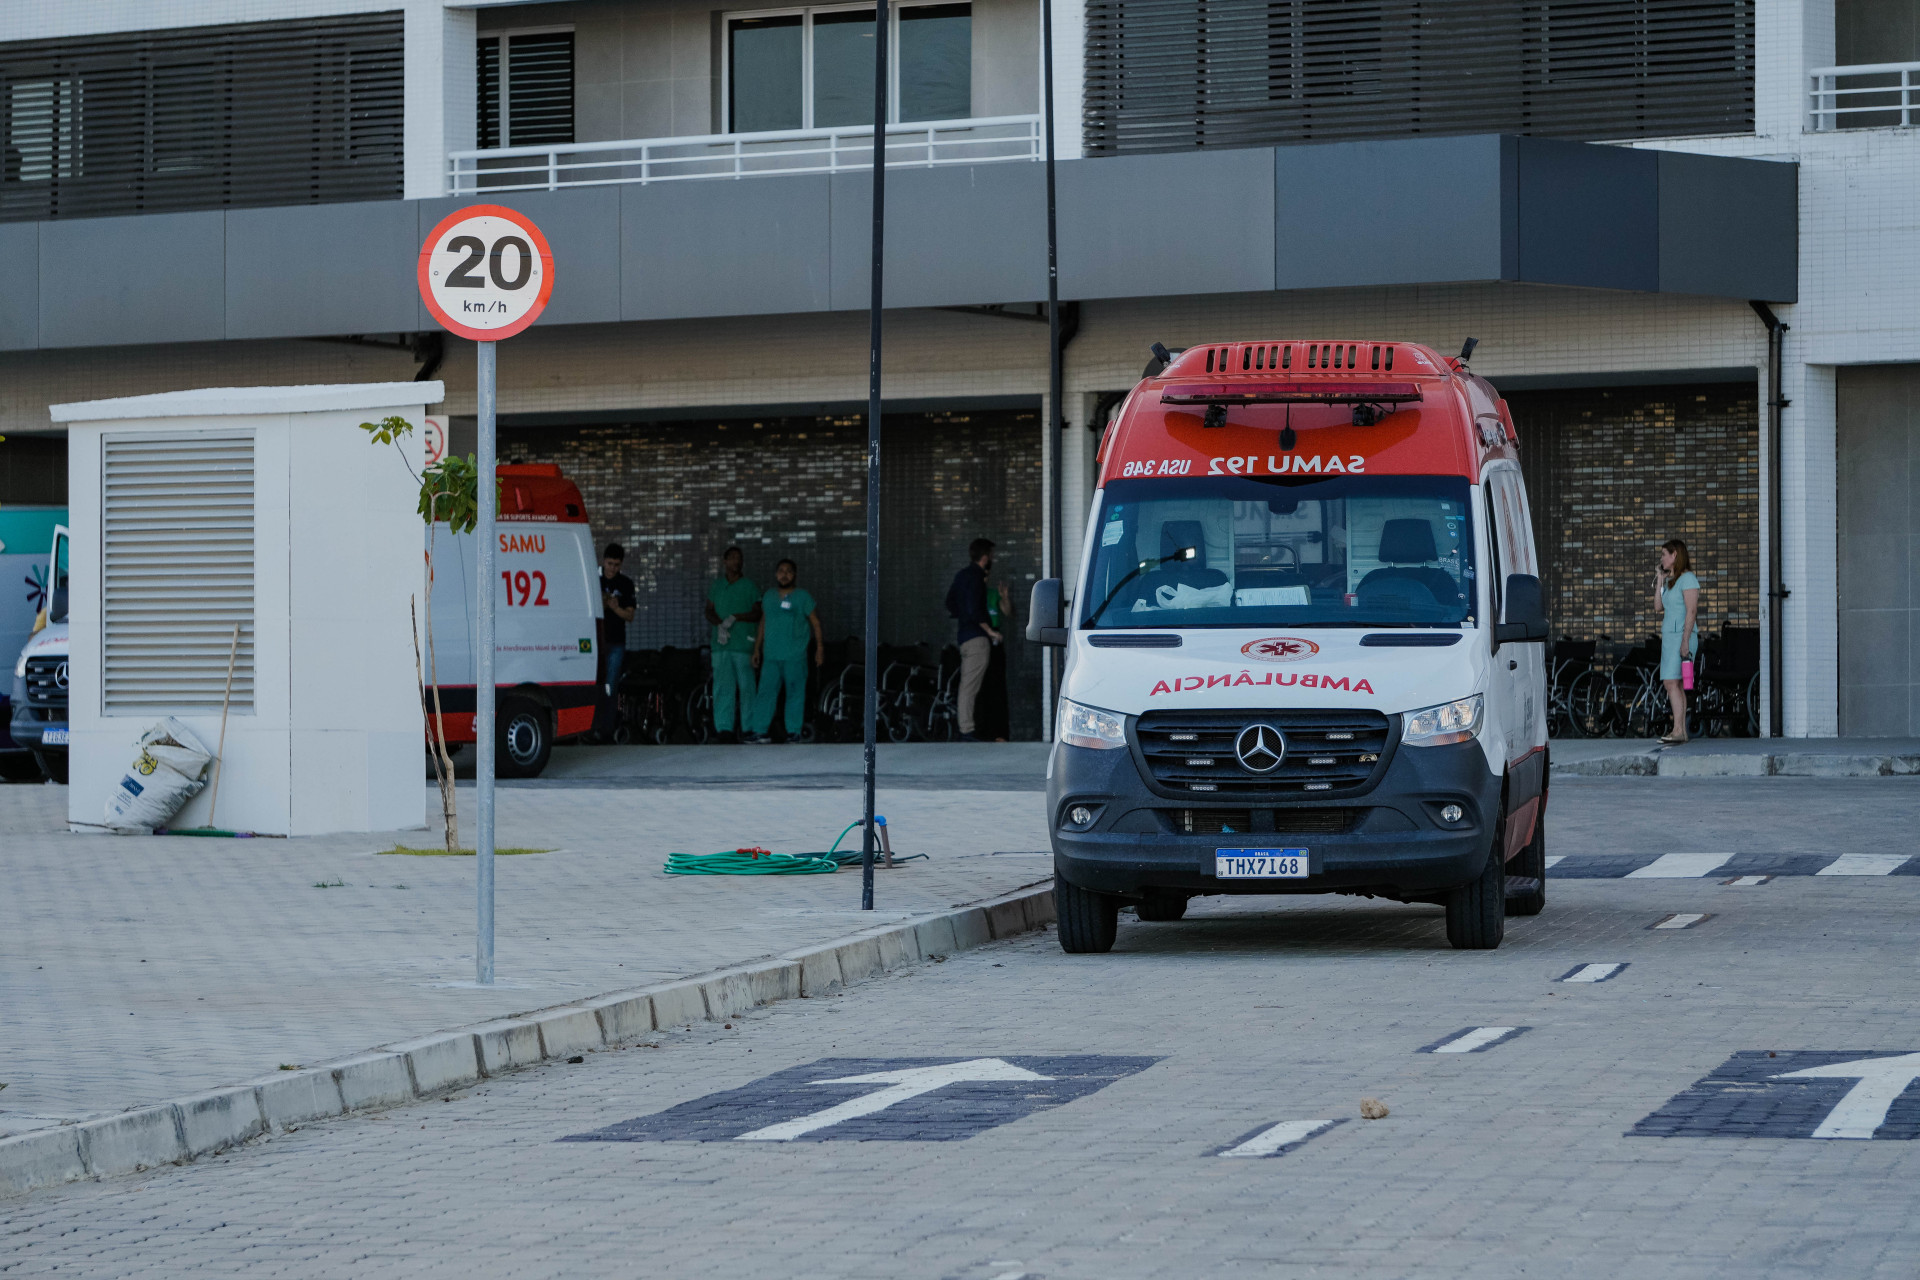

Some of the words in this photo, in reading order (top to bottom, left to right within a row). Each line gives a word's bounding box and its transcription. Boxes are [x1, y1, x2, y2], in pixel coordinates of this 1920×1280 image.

[445, 235, 532, 290] 20
[463, 300, 507, 313] km/h
[499, 533, 546, 554] SAMU
[501, 570, 549, 607] 192
